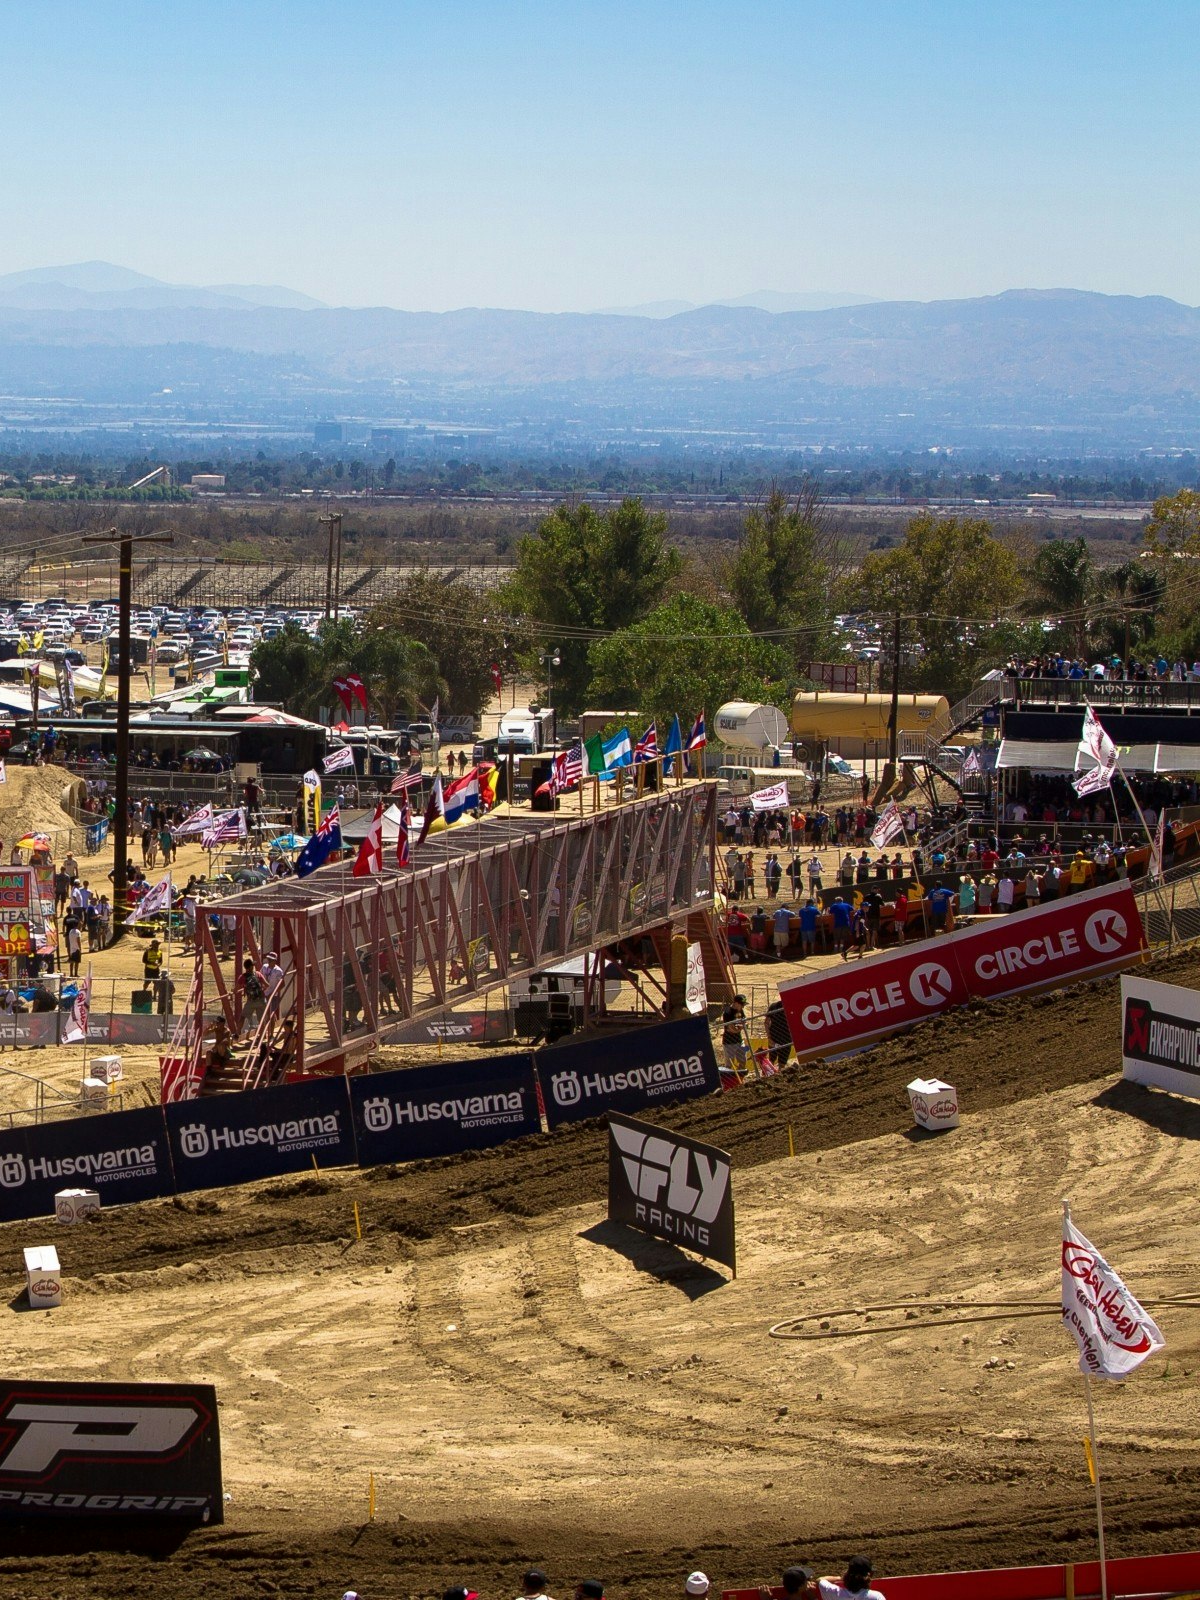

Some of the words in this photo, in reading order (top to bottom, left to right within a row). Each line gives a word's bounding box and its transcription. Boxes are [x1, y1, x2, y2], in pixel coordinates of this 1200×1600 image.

[1093, 684, 1161, 695] MONSTER
[974, 928, 1080, 980] CIRCLE
[1093, 914, 1127, 944] K
[801, 980, 905, 1031] CIRCLE
[918, 968, 952, 999] K
[583, 1055, 703, 1097] Husqvarna
[646, 1077, 706, 1096] MOTORCYCLES
[395, 1091, 522, 1124] Husqvarna
[461, 1114, 524, 1129] MOTORCYCLES
[211, 1114, 338, 1150] Husqvarna
[277, 1136, 340, 1153] MOTORCYCLES
[29, 1144, 155, 1180] Husqvarna
[95, 1166, 157, 1183] MOTORCYCLES
[634, 1132, 730, 1224] FLY
[635, 1202, 710, 1246] RACING
[0, 1403, 199, 1473] P
